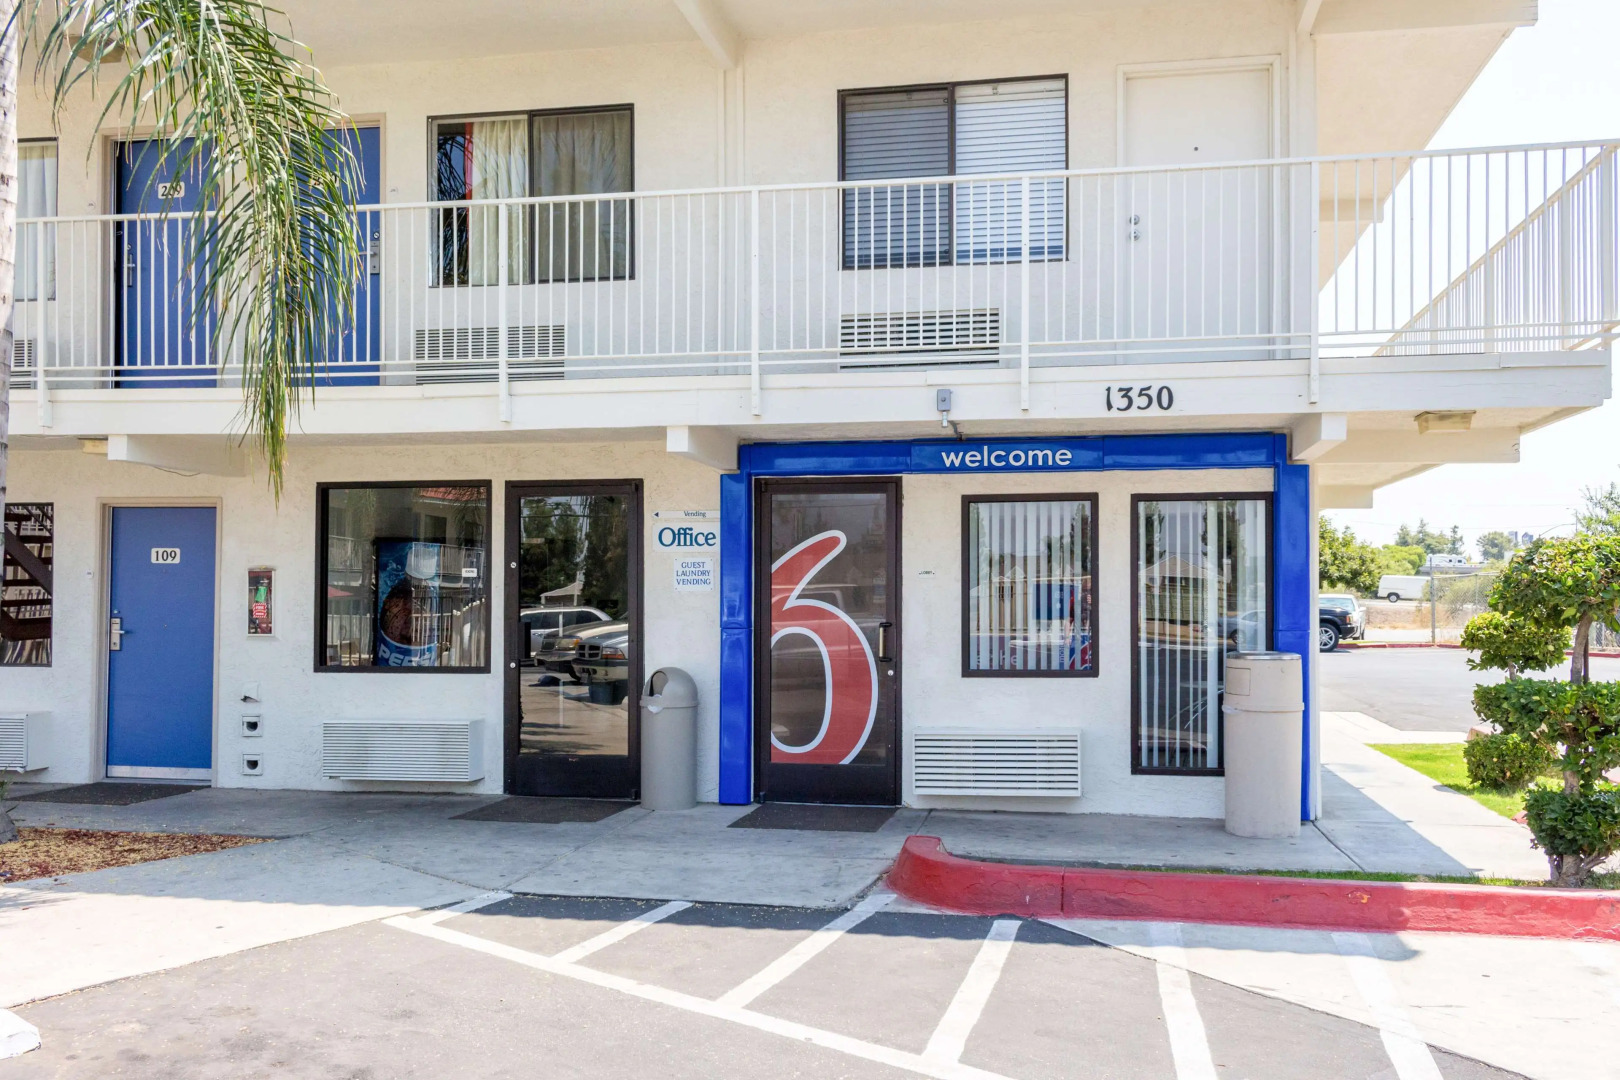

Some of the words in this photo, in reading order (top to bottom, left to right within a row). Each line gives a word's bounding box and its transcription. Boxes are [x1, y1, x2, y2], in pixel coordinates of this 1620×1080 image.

[1105, 385, 1174, 412] 1350
[941, 445, 1073, 468] welcome
[683, 510, 707, 518] Vending
[658, 526, 717, 548] Office
[154, 549, 177, 562] 109
[680, 561, 706, 569] GUEST
[676, 569, 711, 577] LAUNDRY
[676, 578, 711, 586] VENDING
[771, 529, 879, 765] 6
